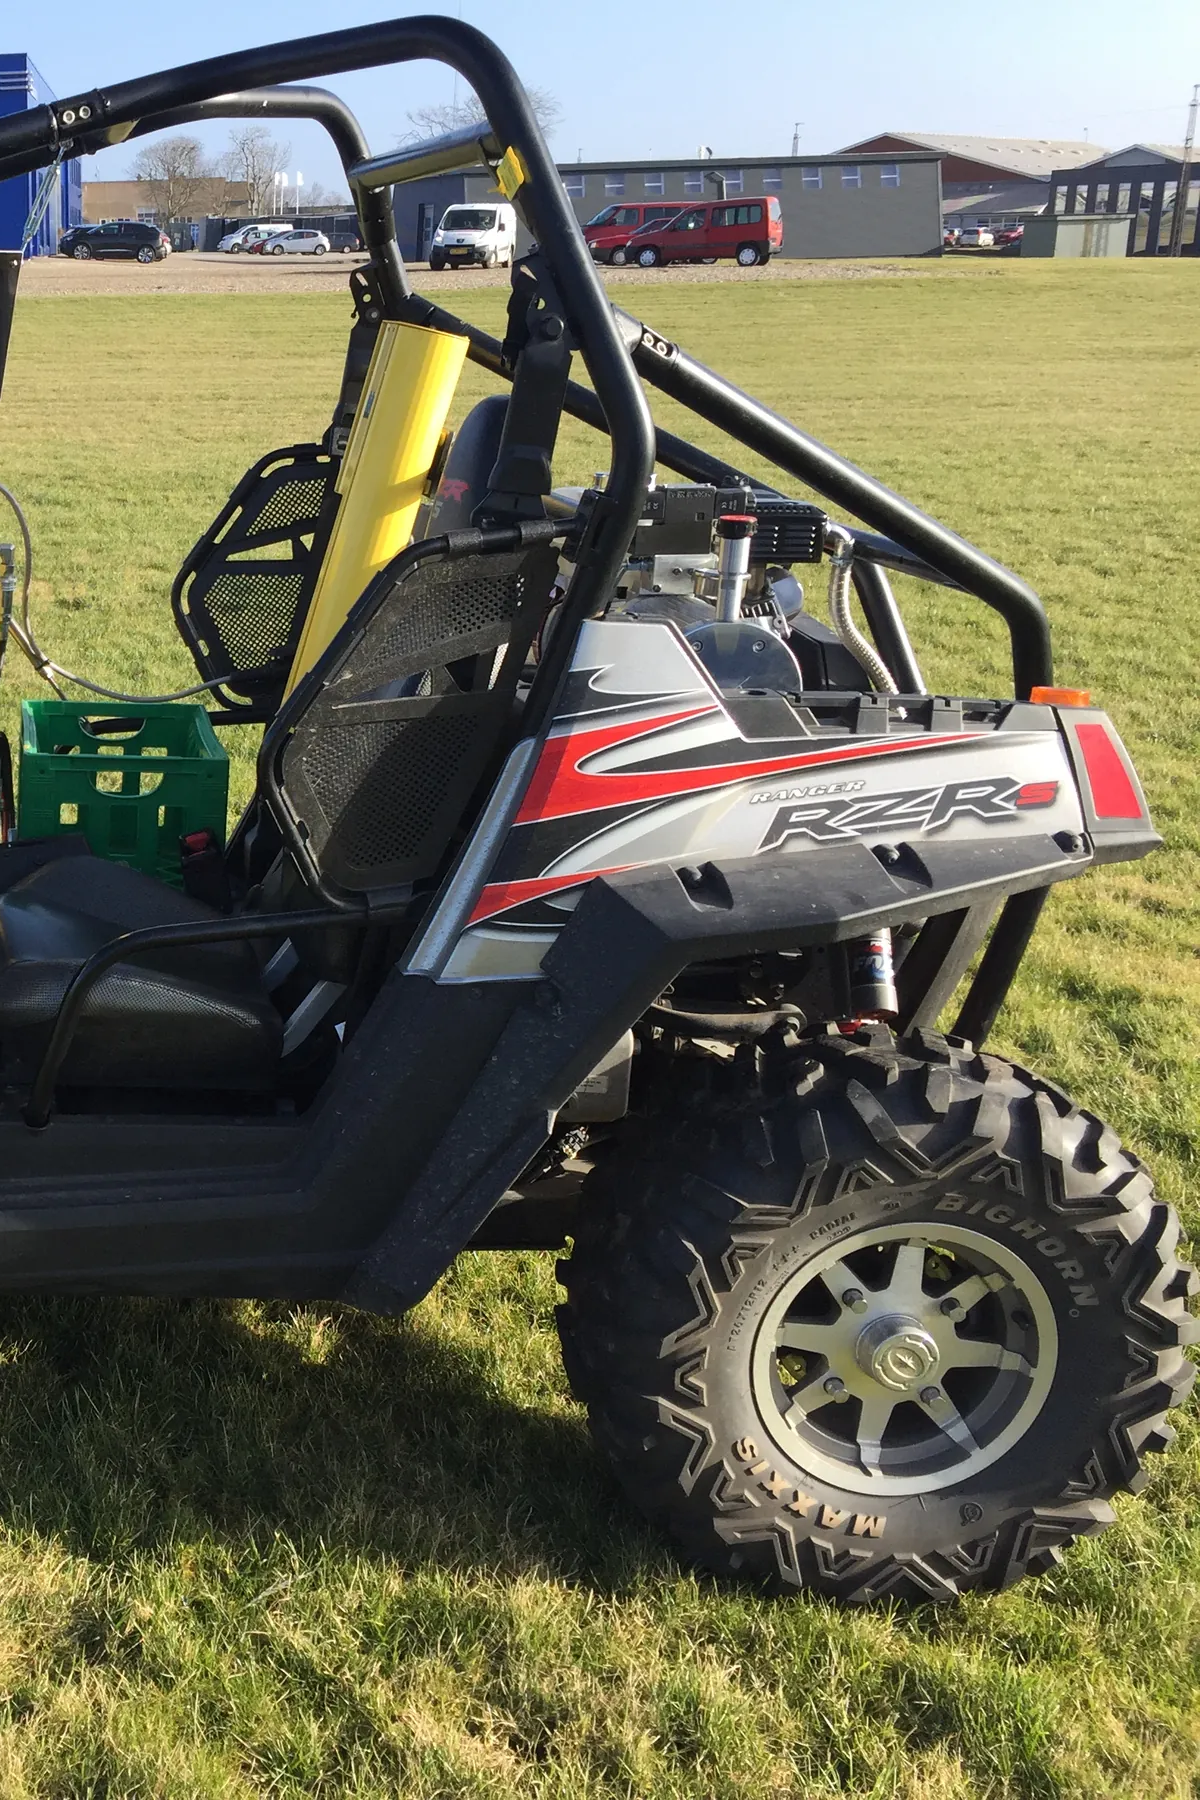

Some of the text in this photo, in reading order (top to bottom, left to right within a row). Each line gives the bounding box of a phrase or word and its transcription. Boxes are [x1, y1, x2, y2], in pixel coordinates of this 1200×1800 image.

[750, 780, 866, 803] RANGER
[934, 1192, 1099, 1306] BIGHORN
[736, 1436, 886, 1537] MAXXIS
